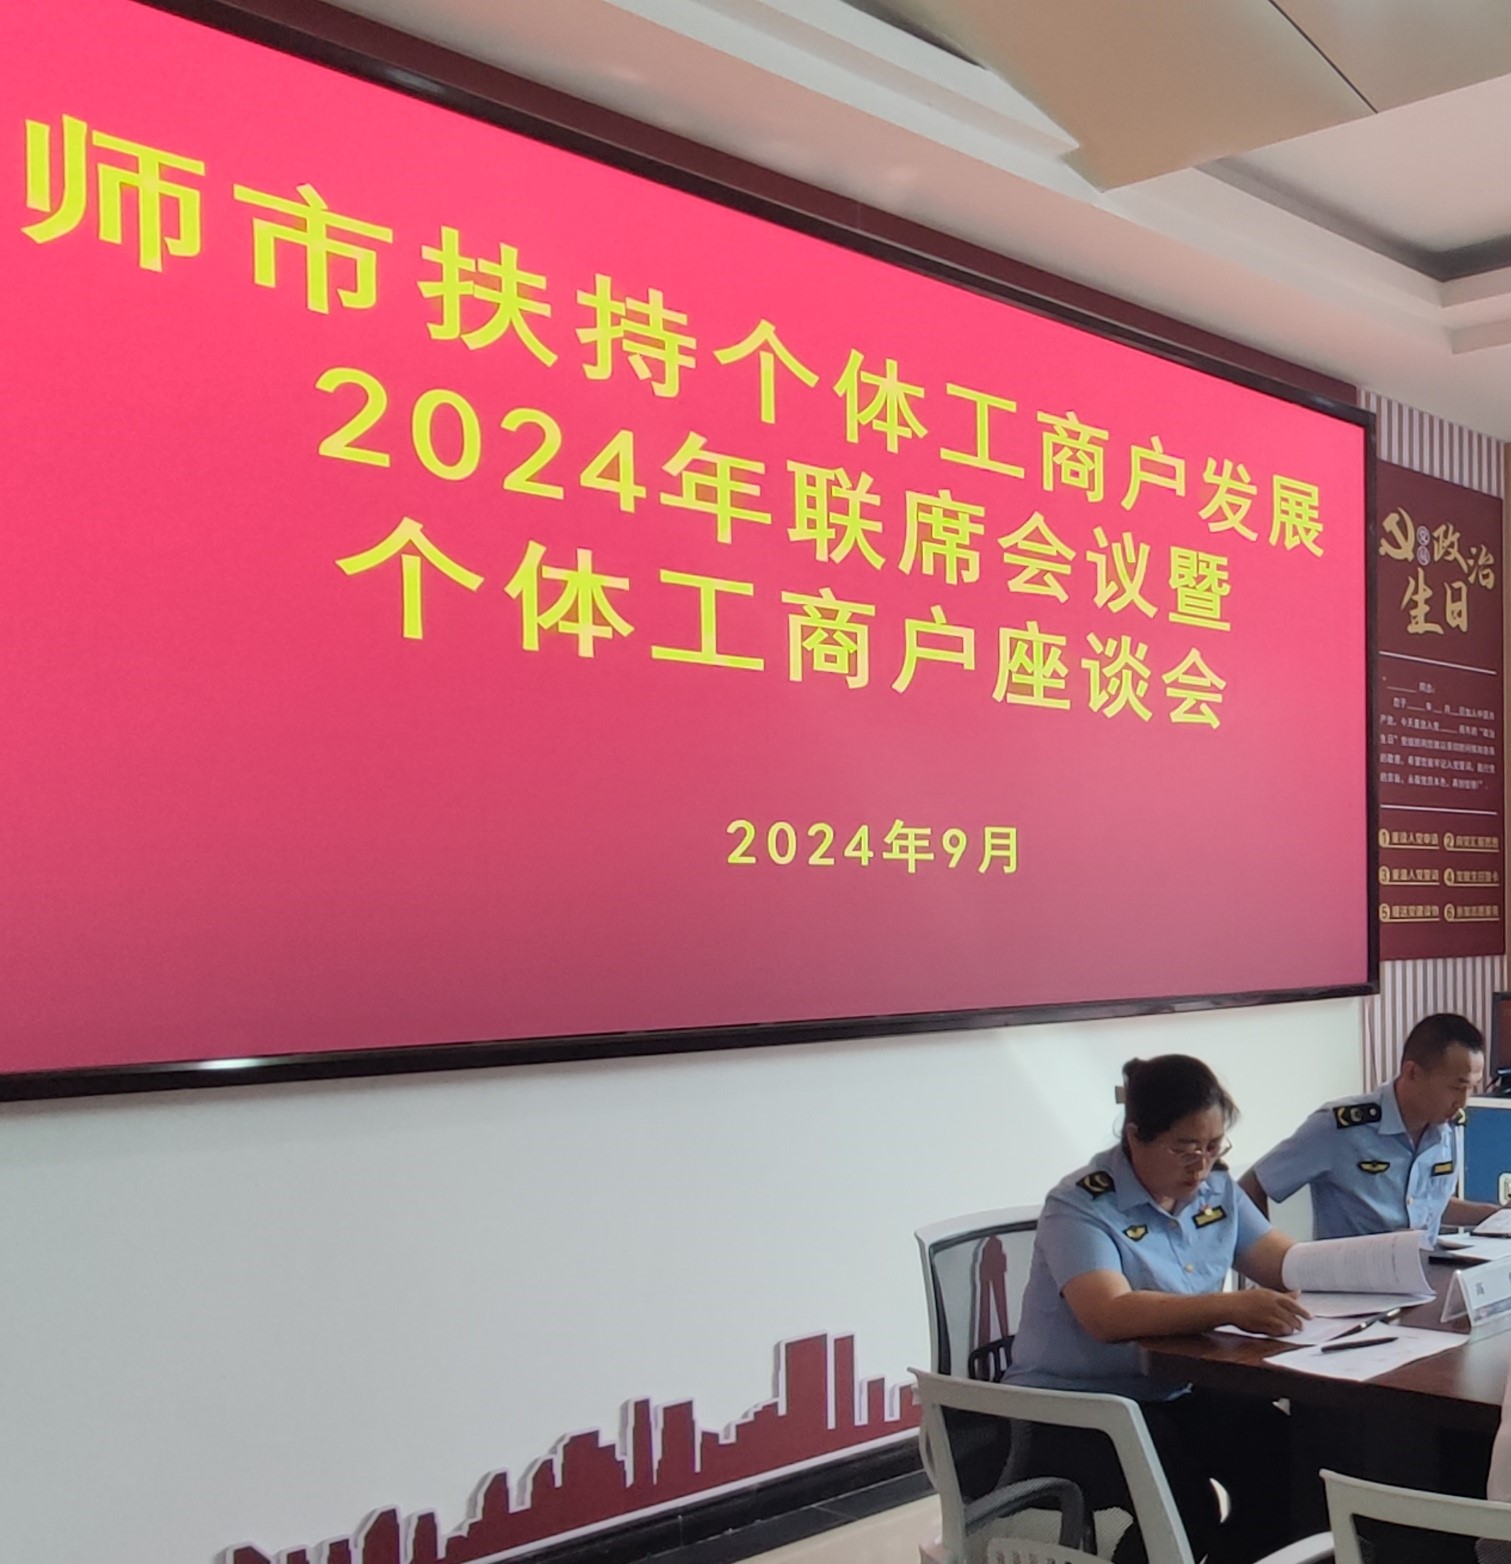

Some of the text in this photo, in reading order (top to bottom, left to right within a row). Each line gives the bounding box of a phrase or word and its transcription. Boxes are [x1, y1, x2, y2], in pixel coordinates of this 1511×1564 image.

[21, 114, 1325, 557] 师市扶持个体工商户发展
[315, 366, 1232, 633] 2024年联席会议暨
[1433, 522, 1496, 590] 政治
[335, 516, 1228, 730] 个体工商户座谈会
[1401, 567, 1469, 636] 生日
[725, 819, 1020, 874] 2024年9月
